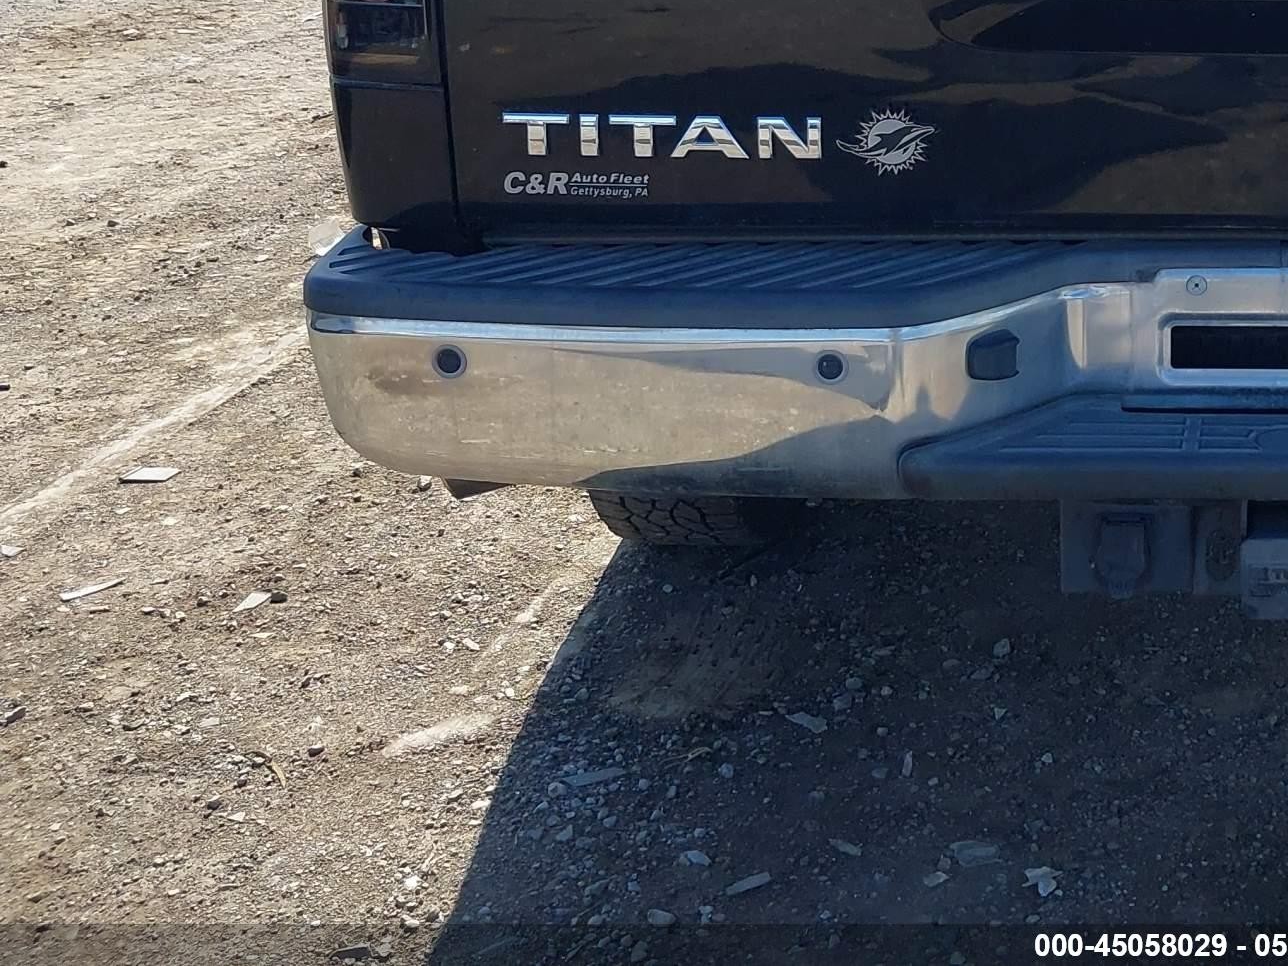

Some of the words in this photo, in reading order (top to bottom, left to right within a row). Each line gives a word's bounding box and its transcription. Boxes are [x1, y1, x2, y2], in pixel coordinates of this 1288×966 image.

[502, 112, 822, 159] TITAN
[503, 171, 569, 195] C&R
[570, 172, 607, 183] Auto
[610, 173, 649, 184] Fleet
[570, 186, 632, 198] Gettysburg,
[634, 188, 649, 196] PA
